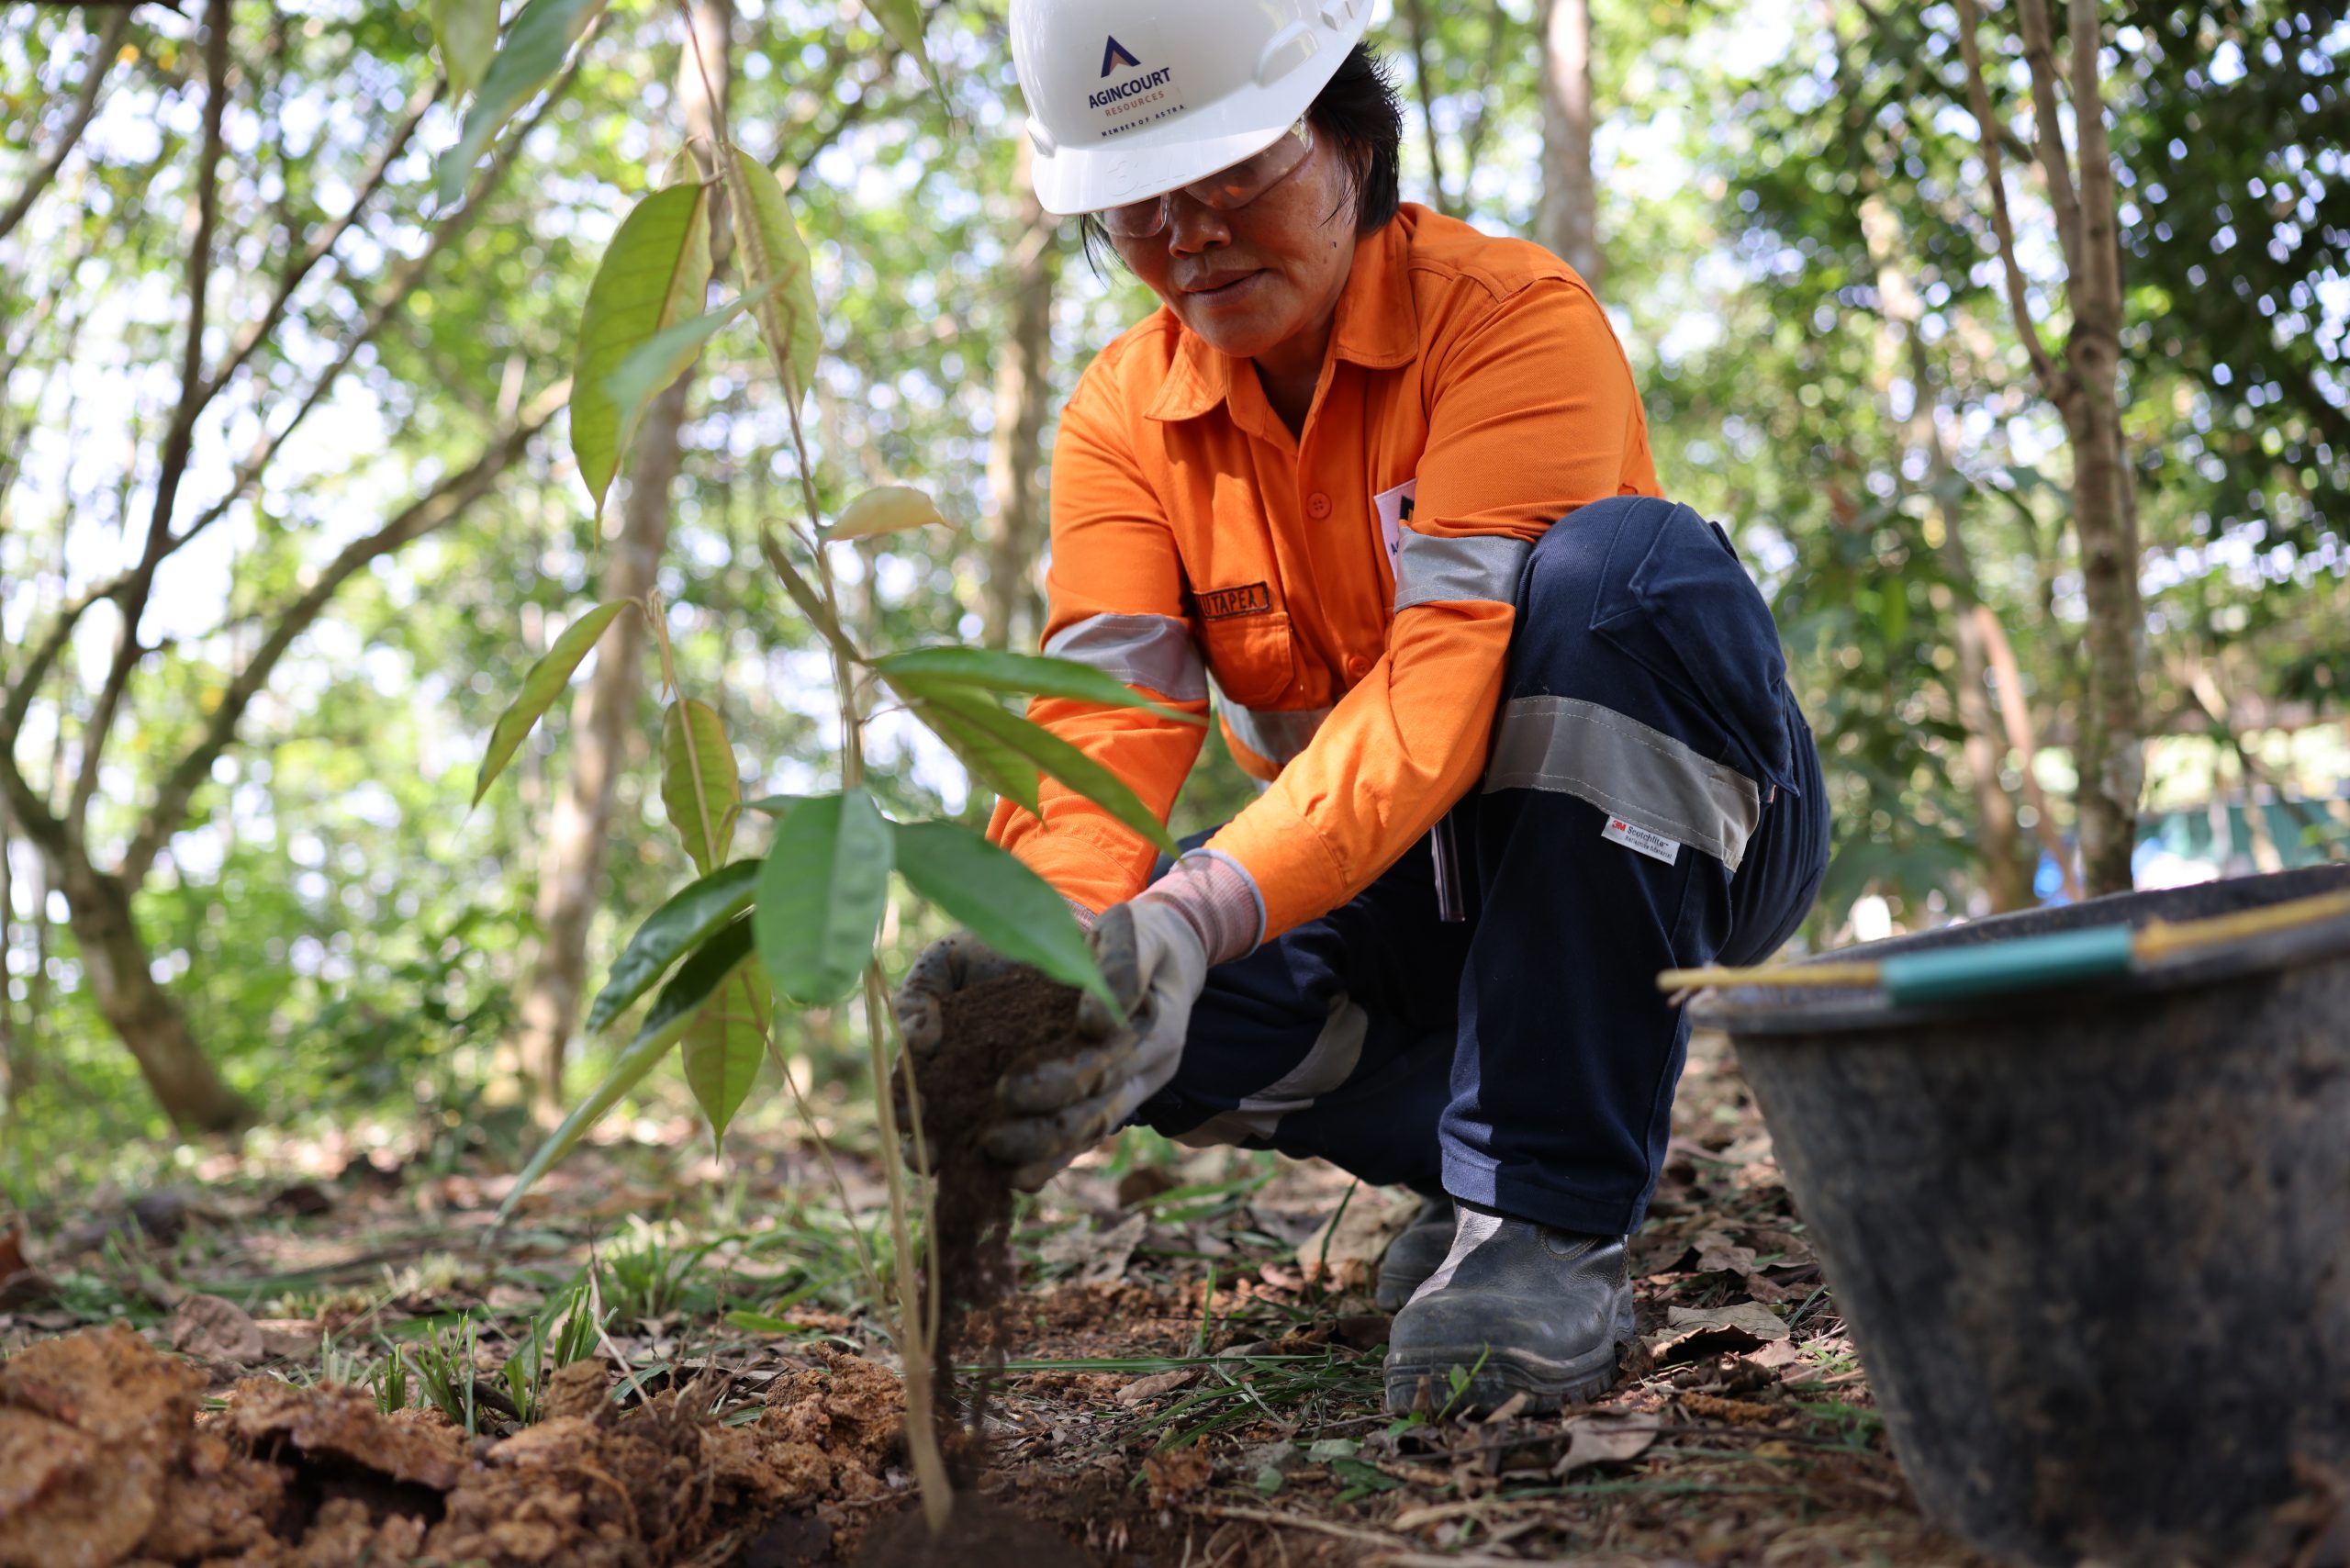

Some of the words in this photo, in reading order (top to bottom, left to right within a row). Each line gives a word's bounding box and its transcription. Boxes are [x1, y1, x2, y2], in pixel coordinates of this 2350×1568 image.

[1089, 67, 1170, 108] AGINCOURT
[1105, 90, 1164, 117] RESOURCES
[1102, 122, 1136, 137] MEMBER
[1138, 117, 1149, 126] OF
[1155, 104, 1184, 119] ASTRA
[1198, 588, 1257, 614] UTAPEA
[1612, 820, 1627, 832] 3M
